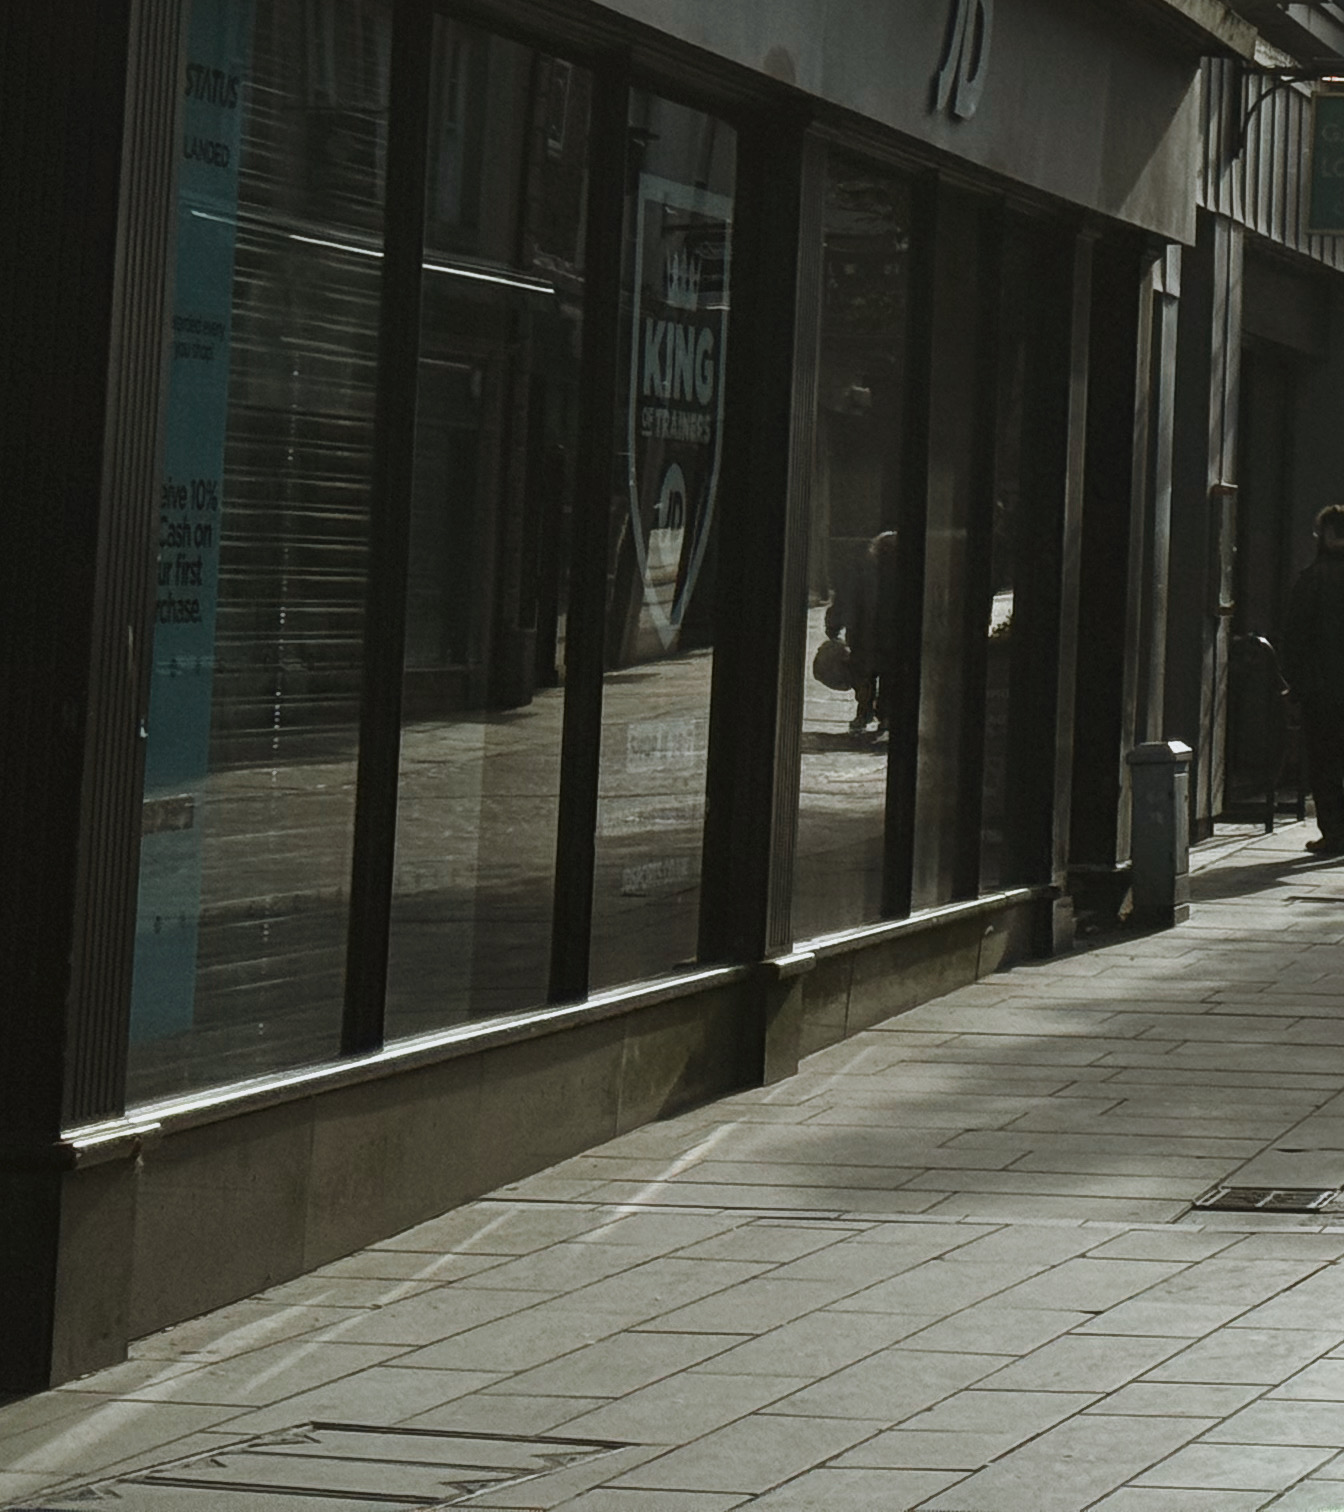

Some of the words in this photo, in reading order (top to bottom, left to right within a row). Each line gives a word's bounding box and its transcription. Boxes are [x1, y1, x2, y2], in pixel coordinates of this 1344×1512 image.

[186, 62, 239, 110] STATUS
[184, 134, 230, 169] LANDED
[644, 316, 716, 406] KING
[656, 407, 712, 445] TRAINERS
[190, 478, 219, 512] 10%
[194, 523, 213, 549] on
[175, 552, 203, 586] first
